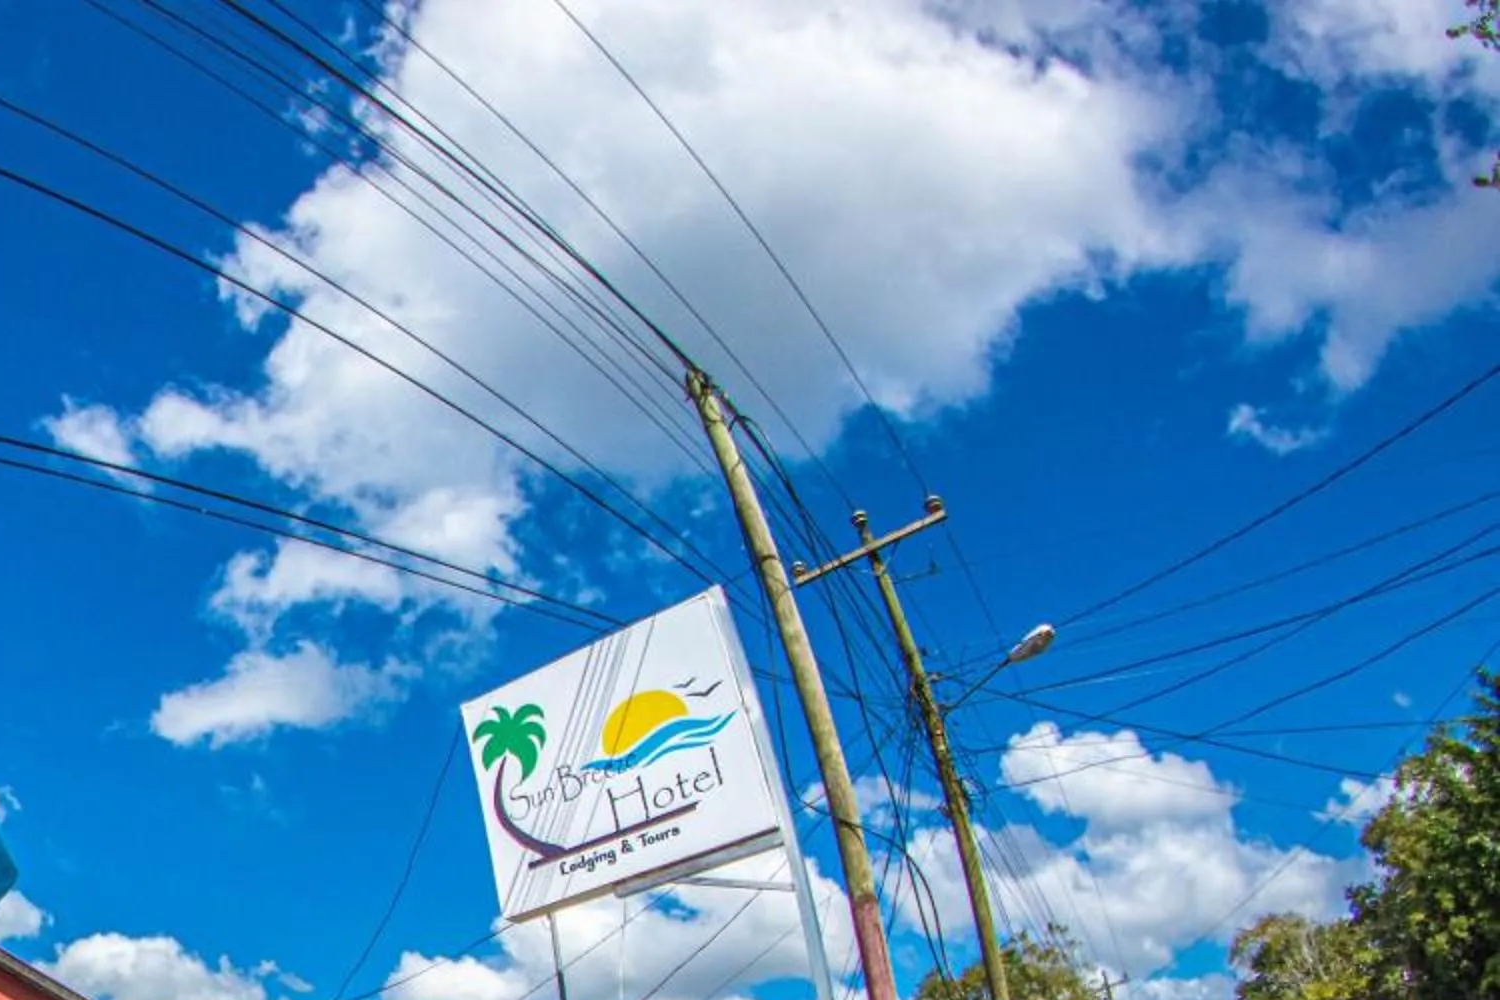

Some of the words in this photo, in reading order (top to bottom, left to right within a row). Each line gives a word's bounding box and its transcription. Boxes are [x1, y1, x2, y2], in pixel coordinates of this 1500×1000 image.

[510, 783, 555, 821] Sun
[607, 747, 723, 832] Hotel
[559, 850, 618, 876] Lodging
[621, 839, 634, 854] &
[638, 826, 681, 848] Tours
